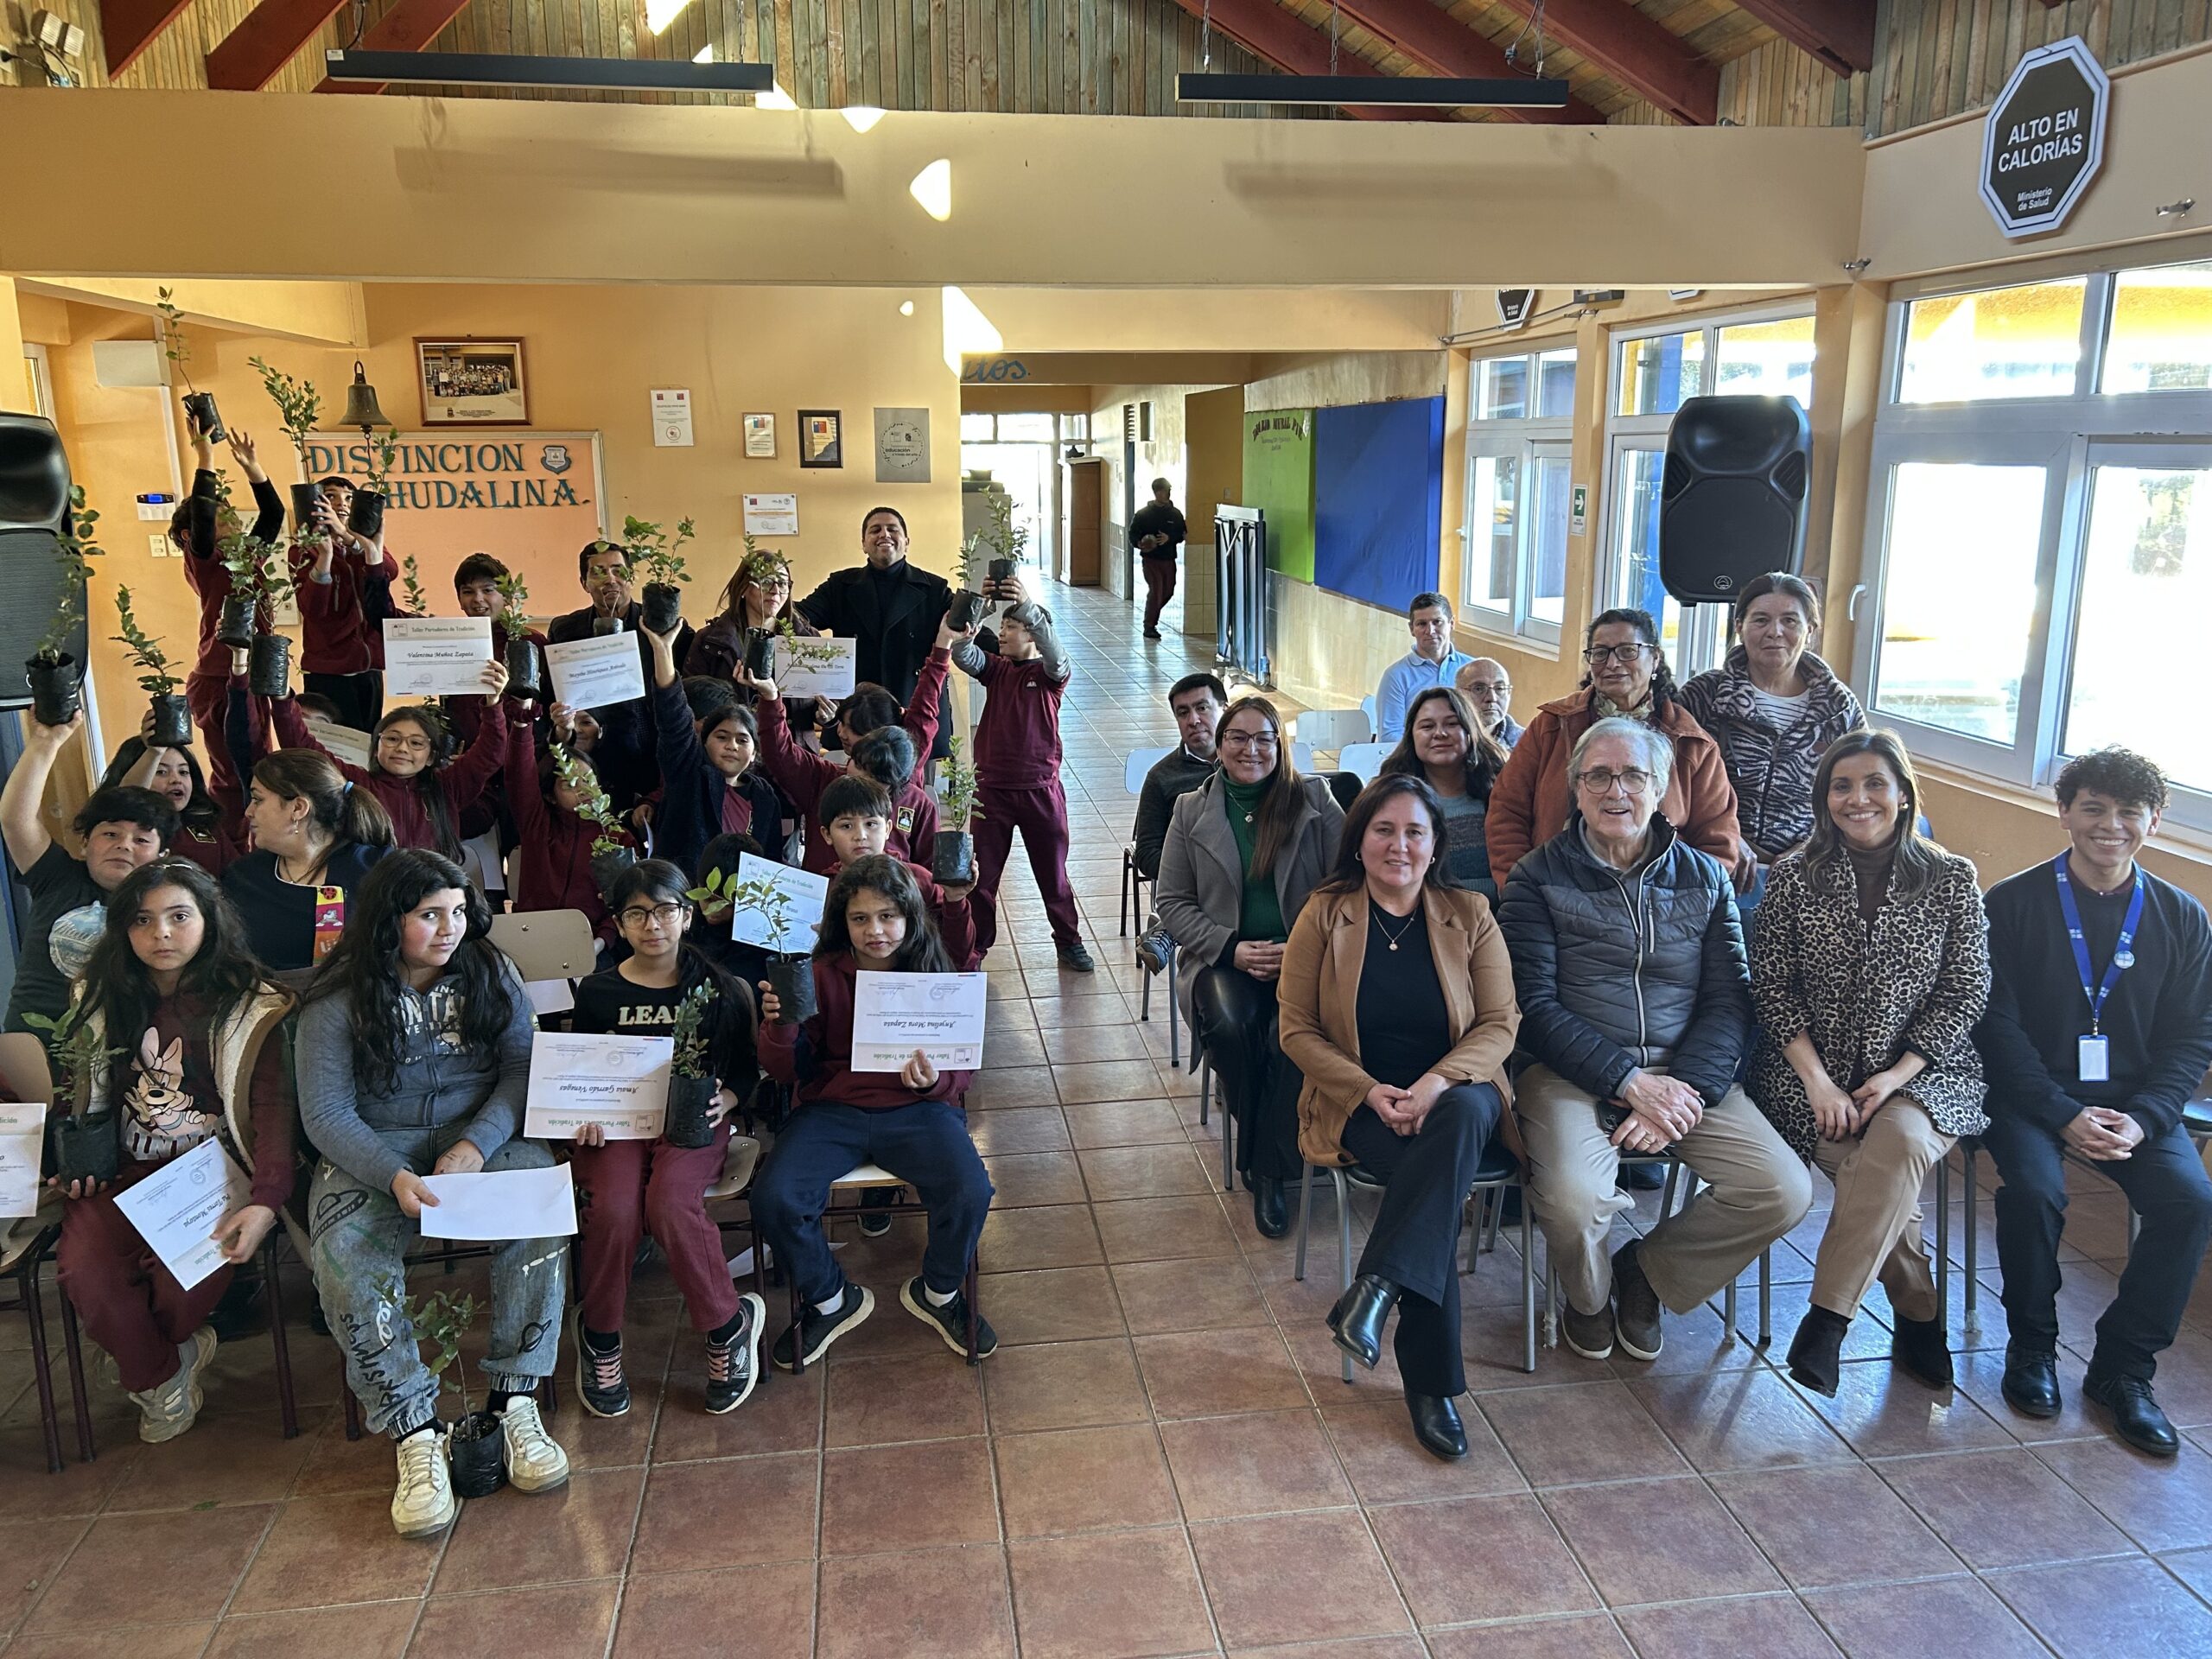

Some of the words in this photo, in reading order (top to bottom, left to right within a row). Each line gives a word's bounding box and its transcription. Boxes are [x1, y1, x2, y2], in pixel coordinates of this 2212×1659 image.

[2007, 116, 2051, 146] ALTO
[2055, 107, 2079, 132] EN
[1998, 133, 2083, 173] CALORÍAS
[2017, 186, 2053, 202] Ministerio
[2018, 200, 2028, 212] de
[2028, 196, 2050, 209] Salud
